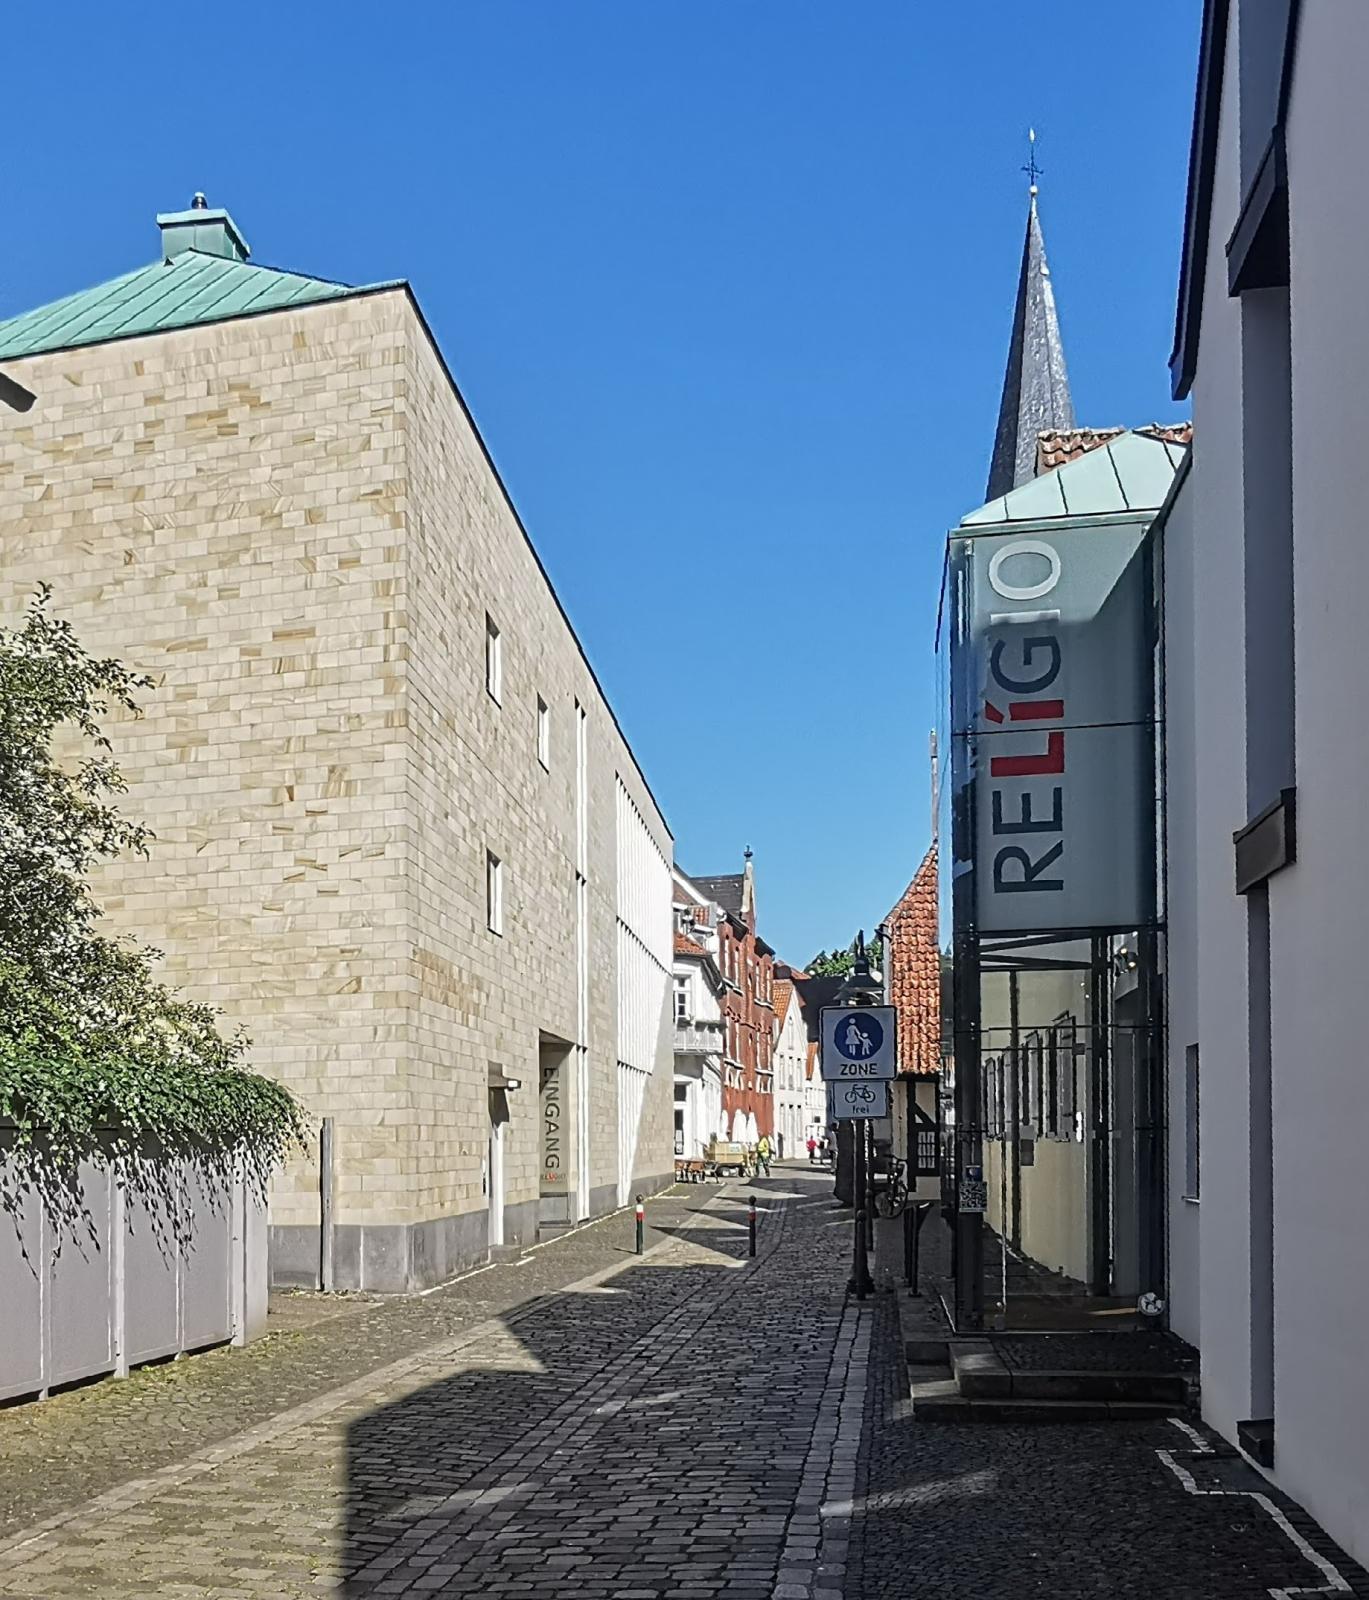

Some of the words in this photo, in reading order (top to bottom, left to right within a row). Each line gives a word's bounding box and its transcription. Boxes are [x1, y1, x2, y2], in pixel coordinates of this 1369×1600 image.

[840, 1063, 878, 1076] ZONE
[852, 1105, 869, 1115] frei
[544, 1067, 560, 1169] EINGANG
